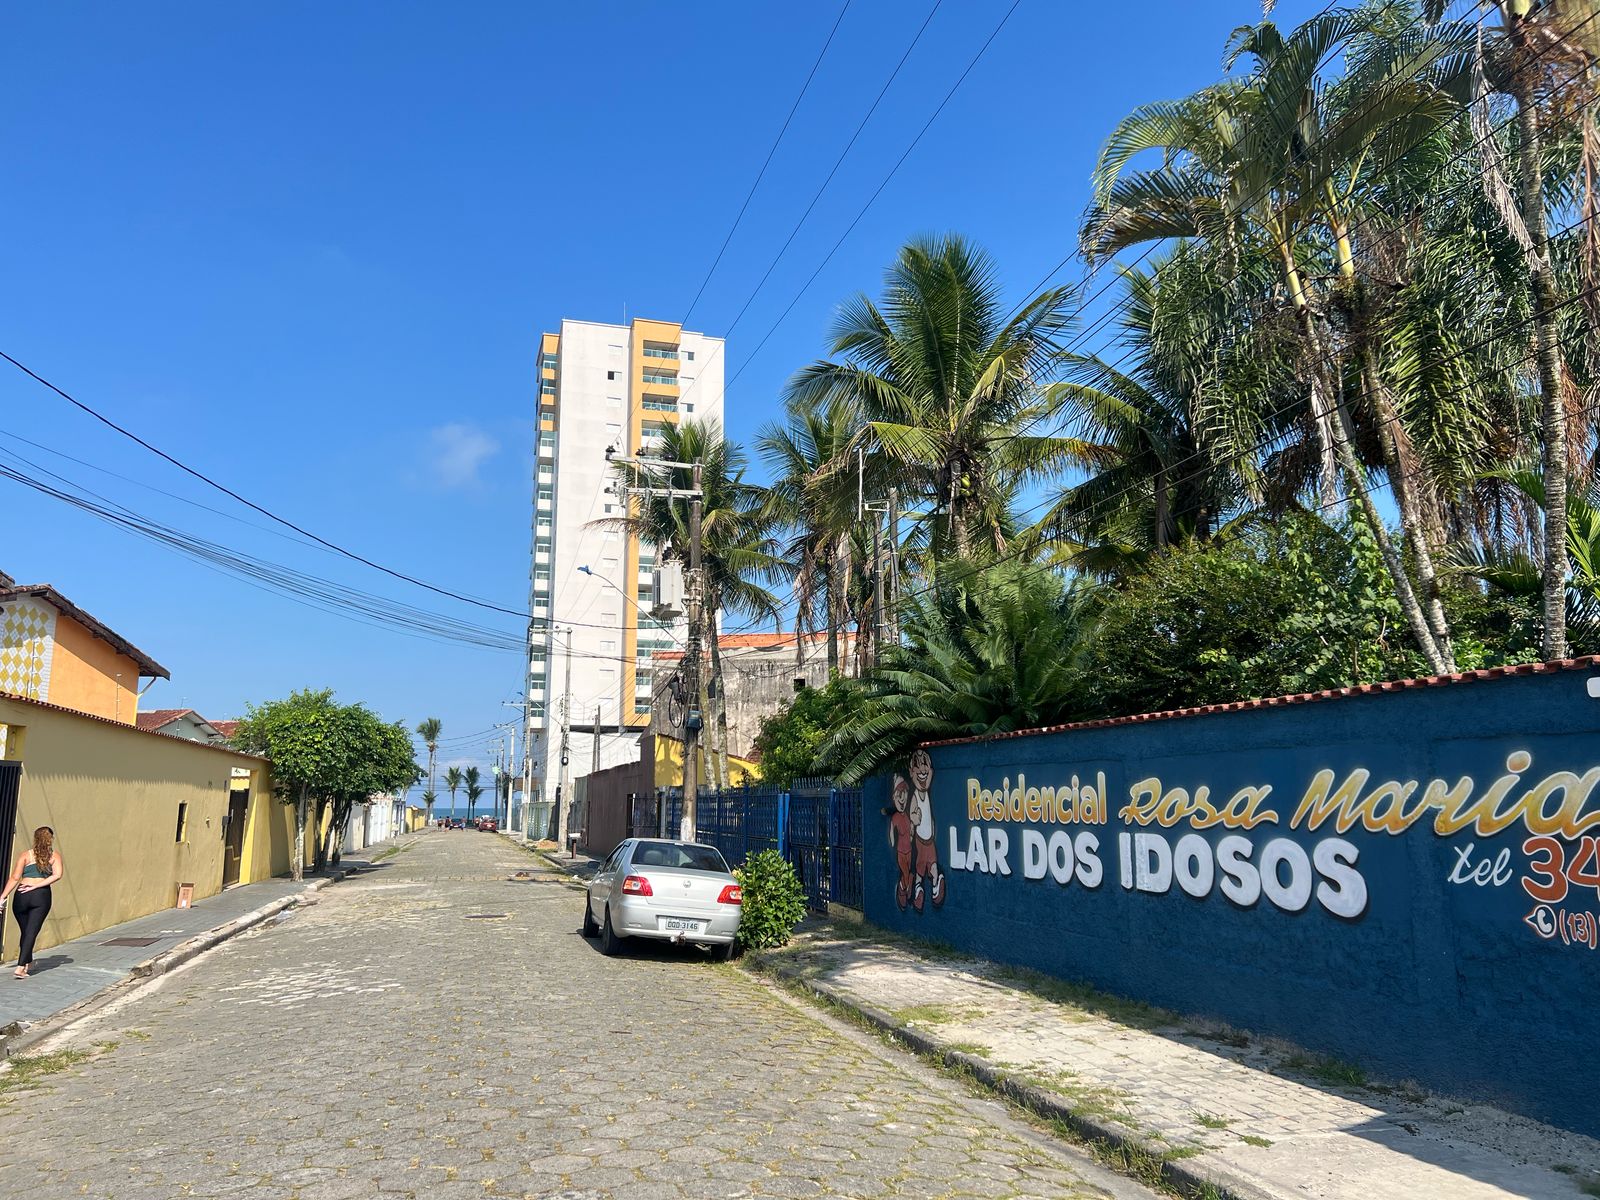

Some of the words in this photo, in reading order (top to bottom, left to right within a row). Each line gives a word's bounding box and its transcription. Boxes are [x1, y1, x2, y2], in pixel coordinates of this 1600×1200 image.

[967, 771, 1107, 825] Residencial
[1118, 777, 1279, 830] Rosa
[1290, 751, 1600, 840] Maria
[949, 825, 1012, 875] LAR
[1022, 829, 1103, 888] DOS
[1118, 832, 1368, 918] IDOSOS
[1447, 842, 1513, 886] tel
[1559, 908, 1597, 950] (13)
